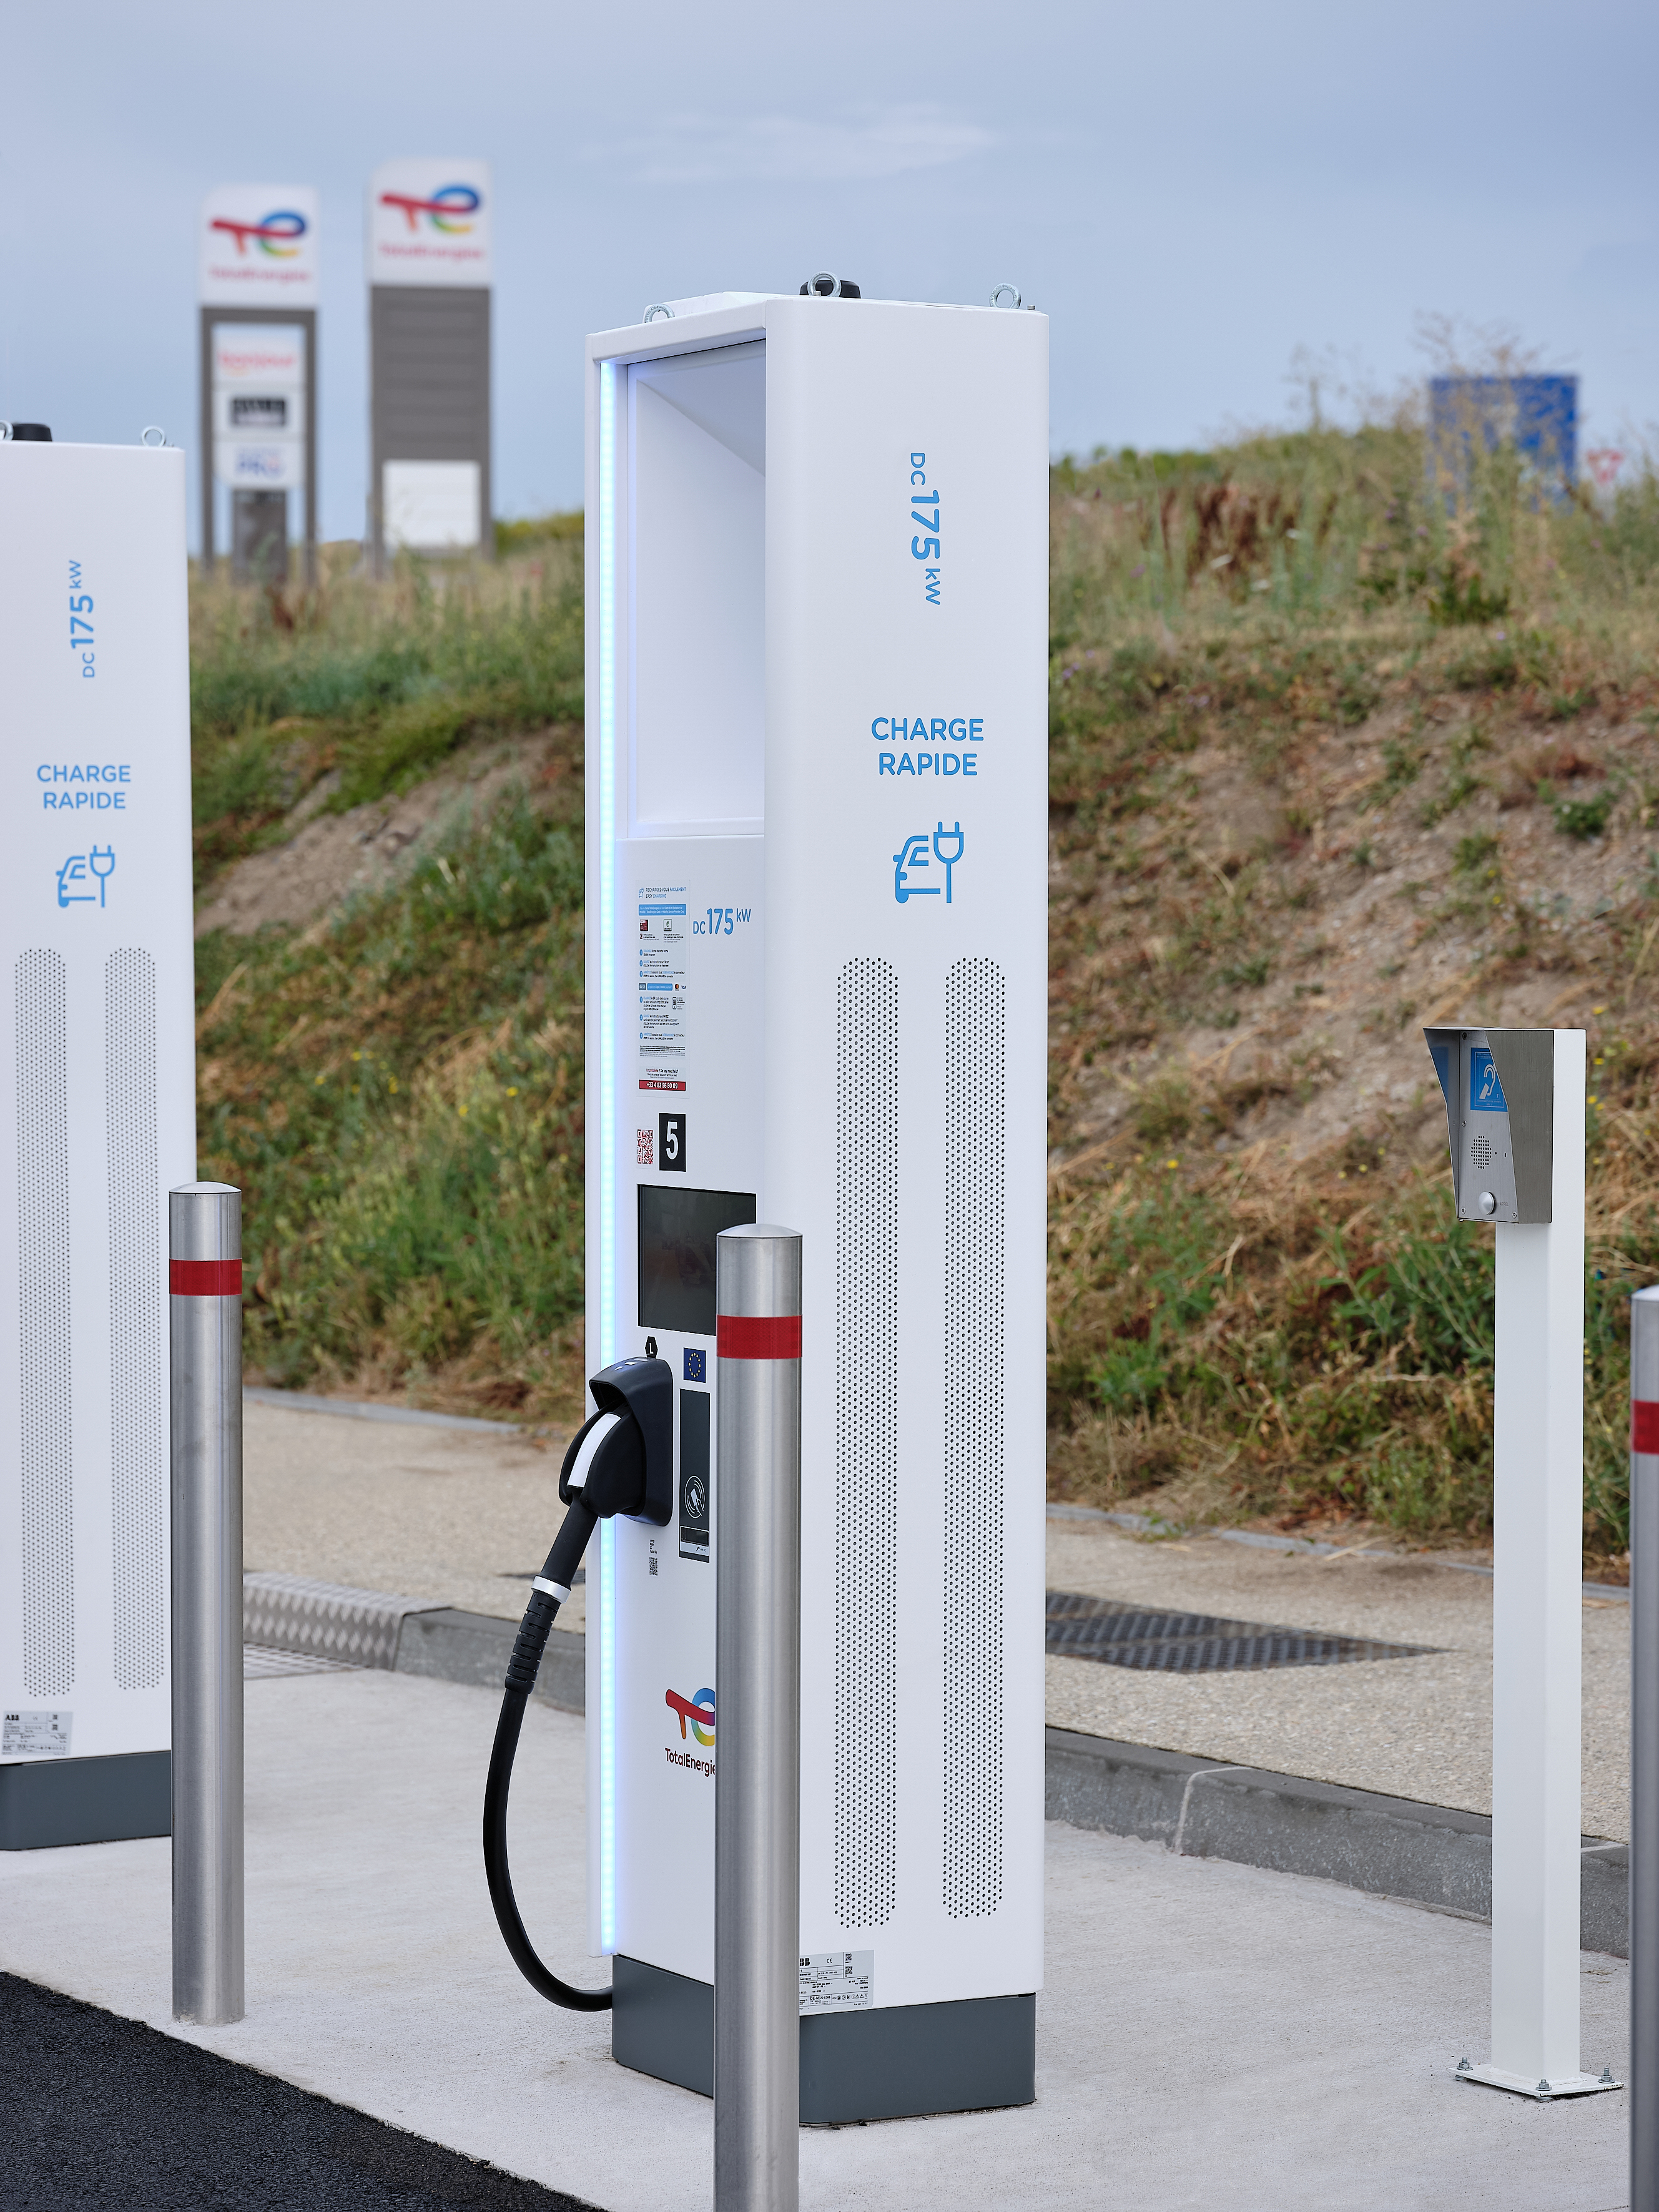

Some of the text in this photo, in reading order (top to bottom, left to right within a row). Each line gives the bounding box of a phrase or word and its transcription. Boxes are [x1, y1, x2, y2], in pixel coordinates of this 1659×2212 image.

[910, 453, 941, 605] DC 175 kW
[69, 560, 95, 678] DC 175 kW
[871, 717, 984, 742] CHARGE
[37, 764, 130, 783] CHARGE
[879, 752, 978, 776] RAPIDE
[43, 792, 126, 809] RAPIDE
[692, 908, 751, 935] DC 175 kW
[666, 1121, 679, 1160] 5
[649, 1342, 654, 1354] L
[664, 1747, 716, 1777] TotalEnergie
[799, 1957, 810, 1967] BB
